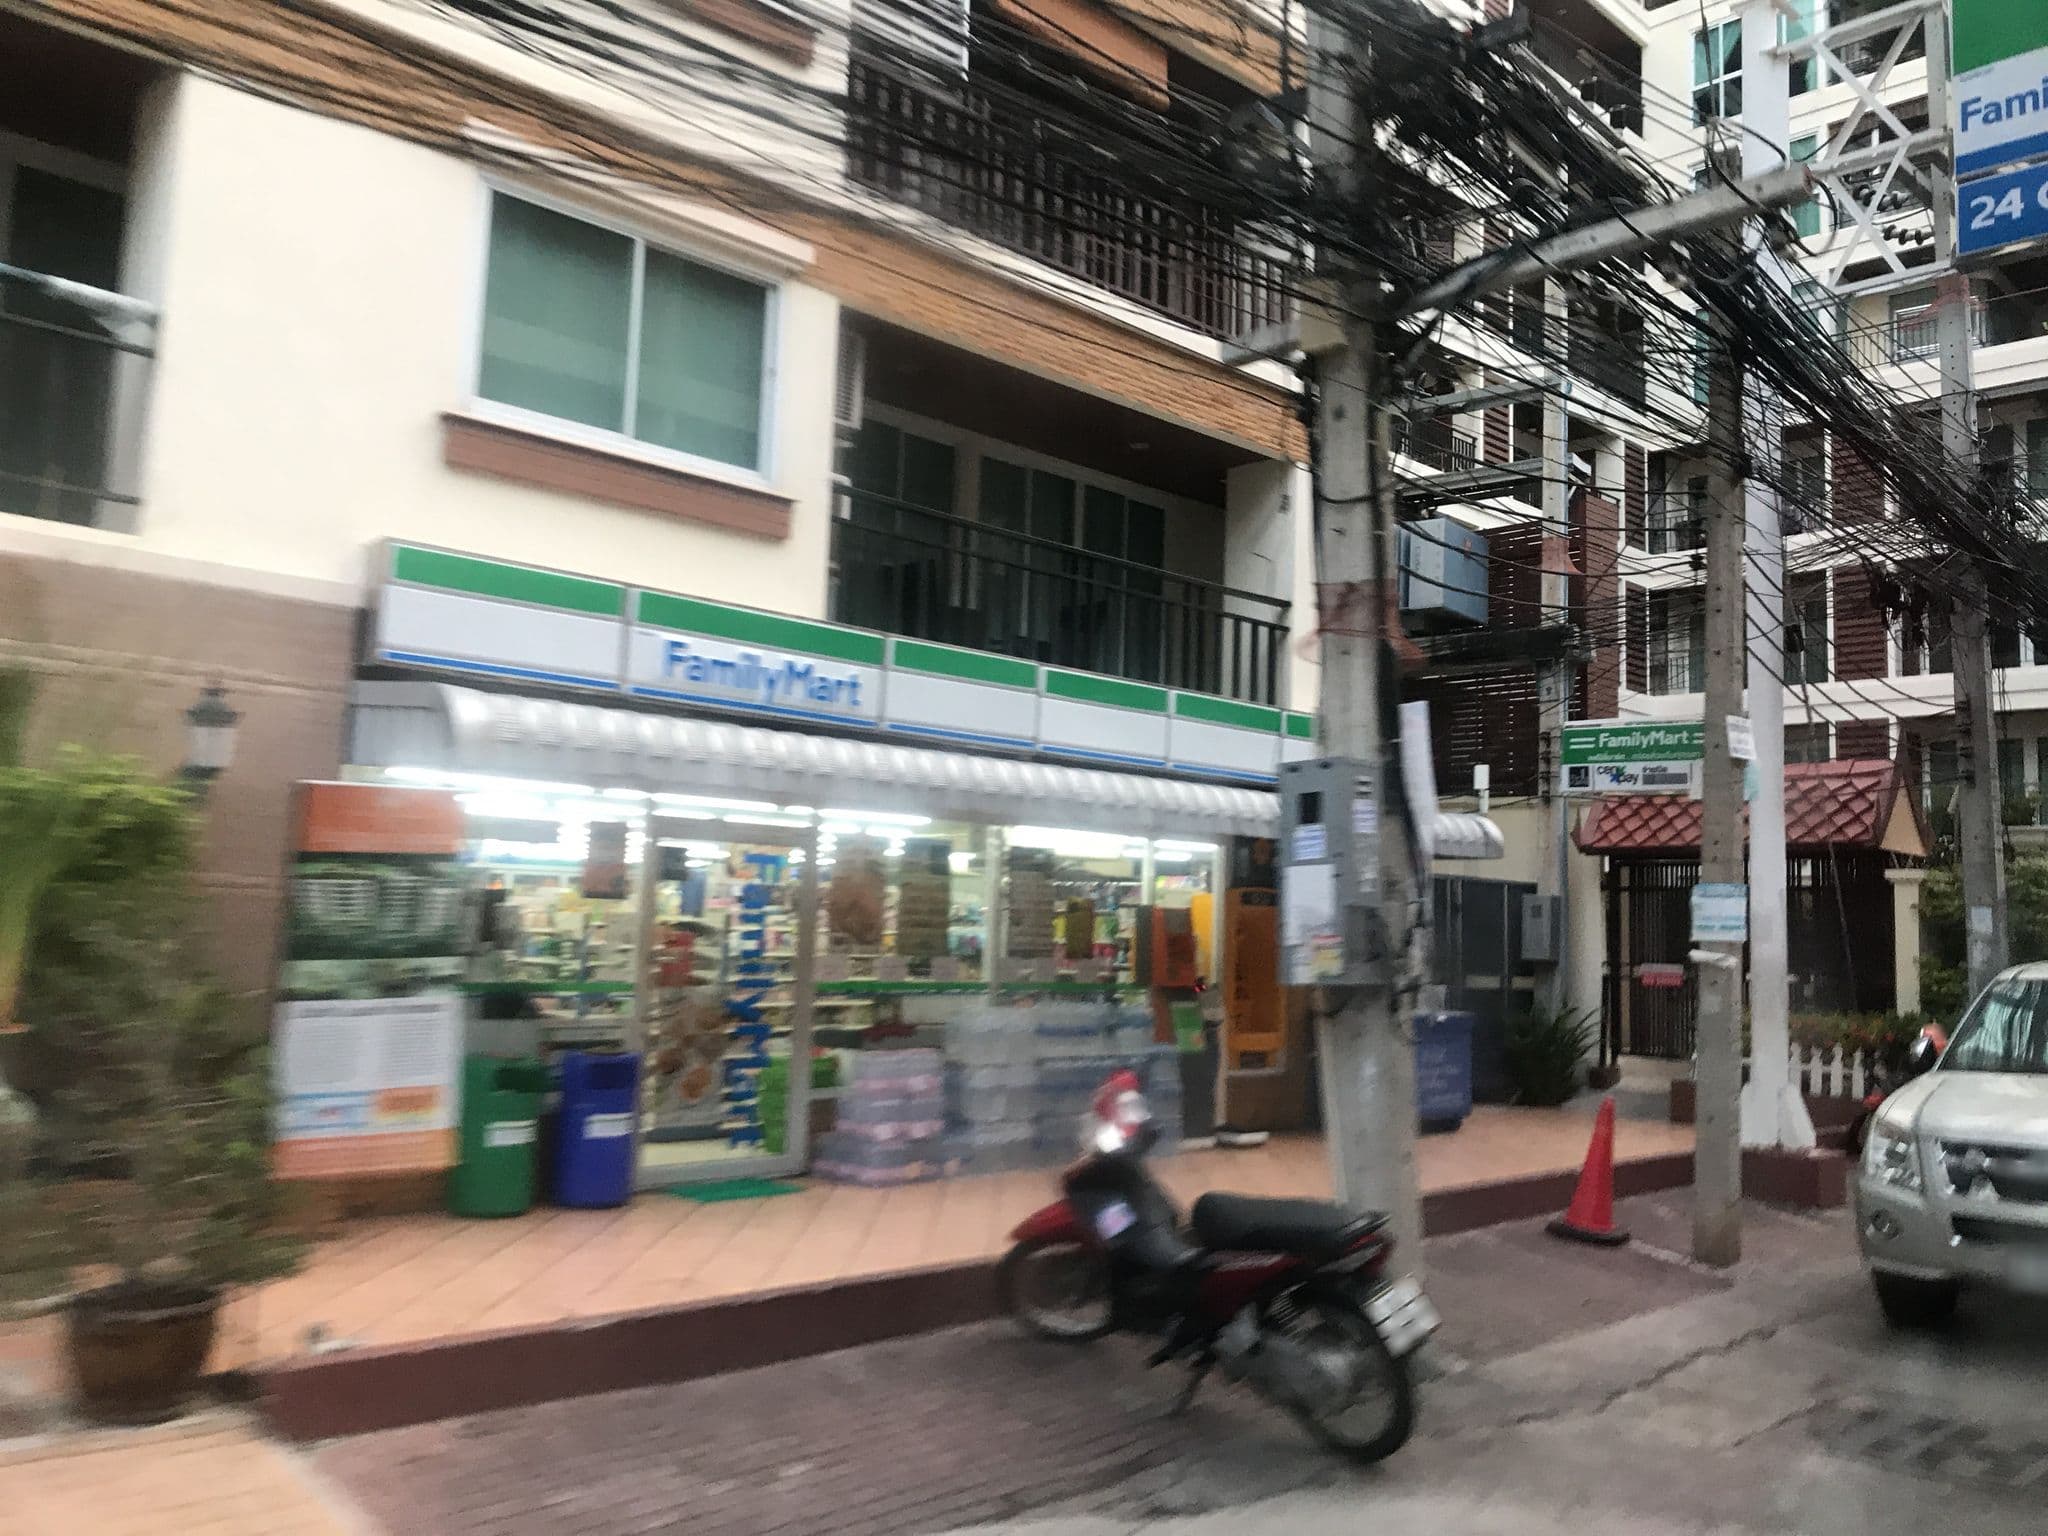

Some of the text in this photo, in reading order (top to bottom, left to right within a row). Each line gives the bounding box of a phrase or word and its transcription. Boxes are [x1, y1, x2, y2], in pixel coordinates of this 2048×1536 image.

[1961, 76, 2048, 132] Fami
[1969, 187, 2025, 230] 24
[663, 638, 862, 707] FamilyMart
[1598, 730, 1689, 749] FamilyMart
[723, 853, 787, 1148] FamilyMart
